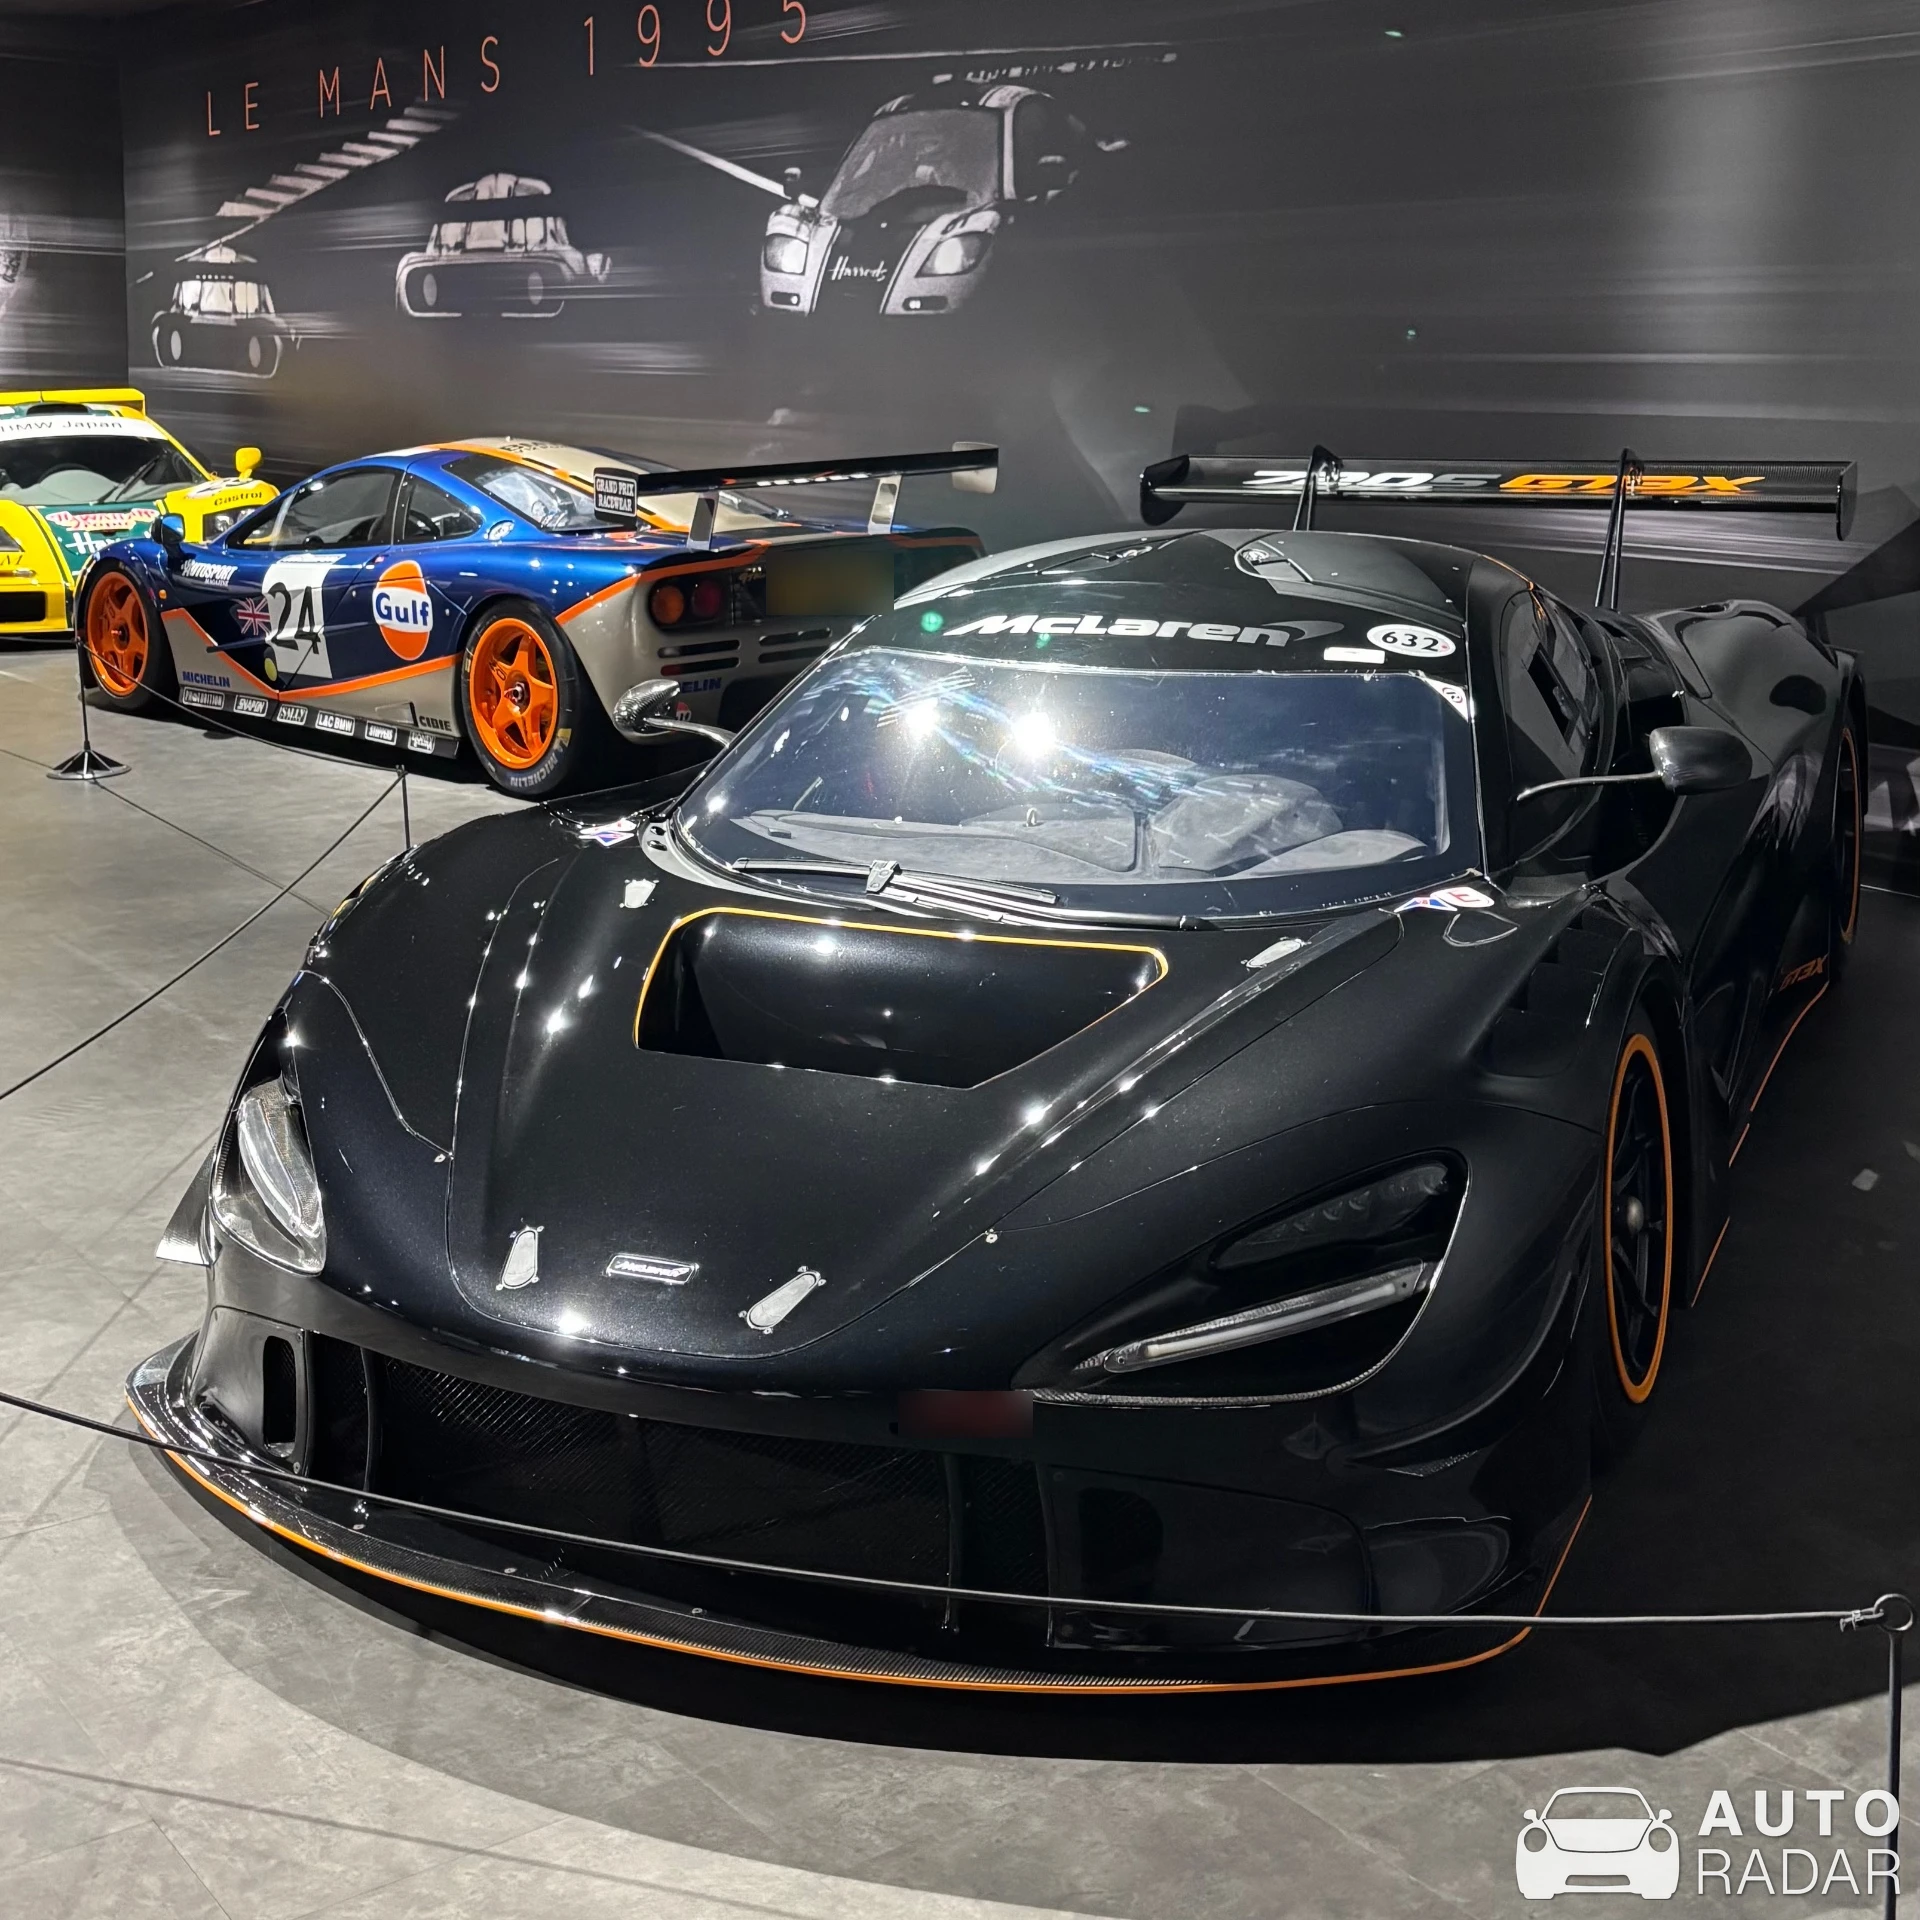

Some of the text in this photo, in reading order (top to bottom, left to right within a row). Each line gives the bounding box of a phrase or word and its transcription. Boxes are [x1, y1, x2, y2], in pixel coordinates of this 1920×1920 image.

[207, 0, 807, 136] LE MANS 1995
[62, 420, 123, 430] Japan
[596, 478, 635, 497] GRAND PRIX
[1500, 474, 1766, 492] GT3X
[598, 493, 633, 512] RACEWEAR
[181, 559, 239, 580] AUTOSPORT
[267, 582, 322, 655] 24
[375, 592, 430, 626] Gulf
[943, 614, 1290, 647] McLaren
[1381, 631, 1440, 652] 632
[182, 671, 231, 688] MICHELIN
[509, 751, 559, 788] MICHELIN
